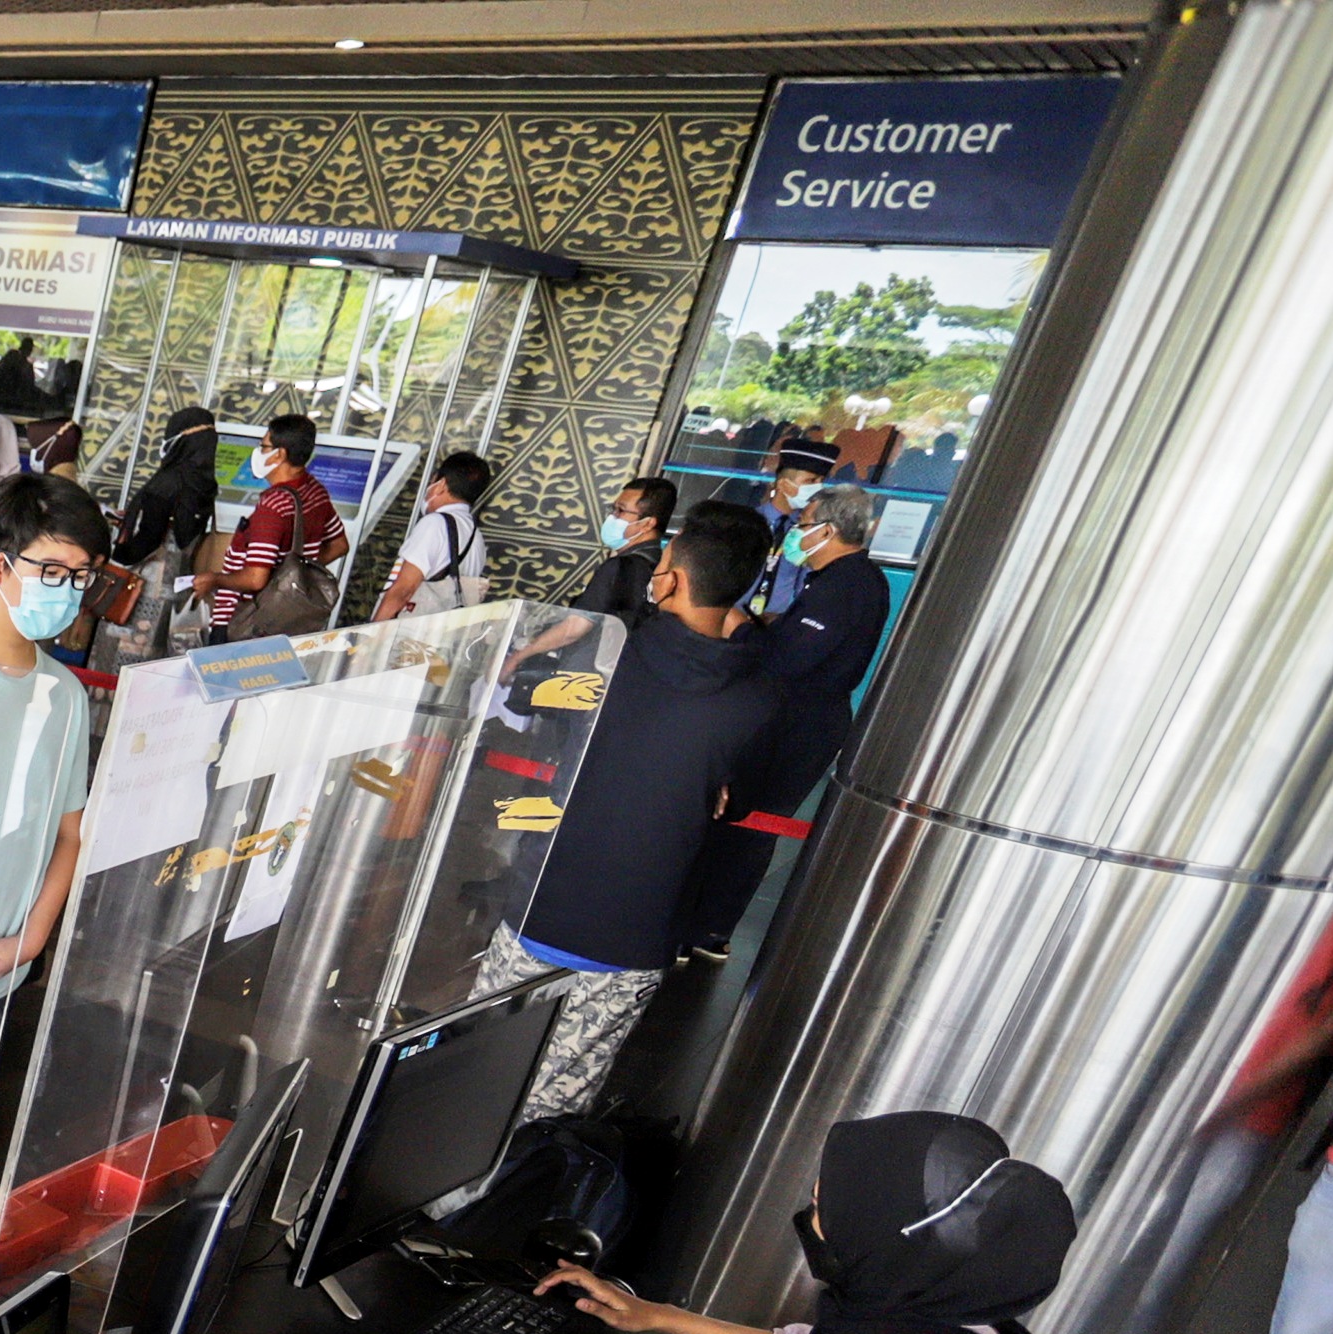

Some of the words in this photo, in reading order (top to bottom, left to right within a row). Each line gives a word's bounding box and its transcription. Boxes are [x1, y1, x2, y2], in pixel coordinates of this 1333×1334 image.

[797, 114, 1013, 153] Customer
[776, 169, 936, 210] Service
[126, 220, 208, 240] LAYANAN
[213, 225, 318, 246] INFORMASI
[322, 231, 398, 250] PUBLIK
[199, 650, 294, 675] PENGAMBILAN
[239, 673, 279, 690] HASIL
